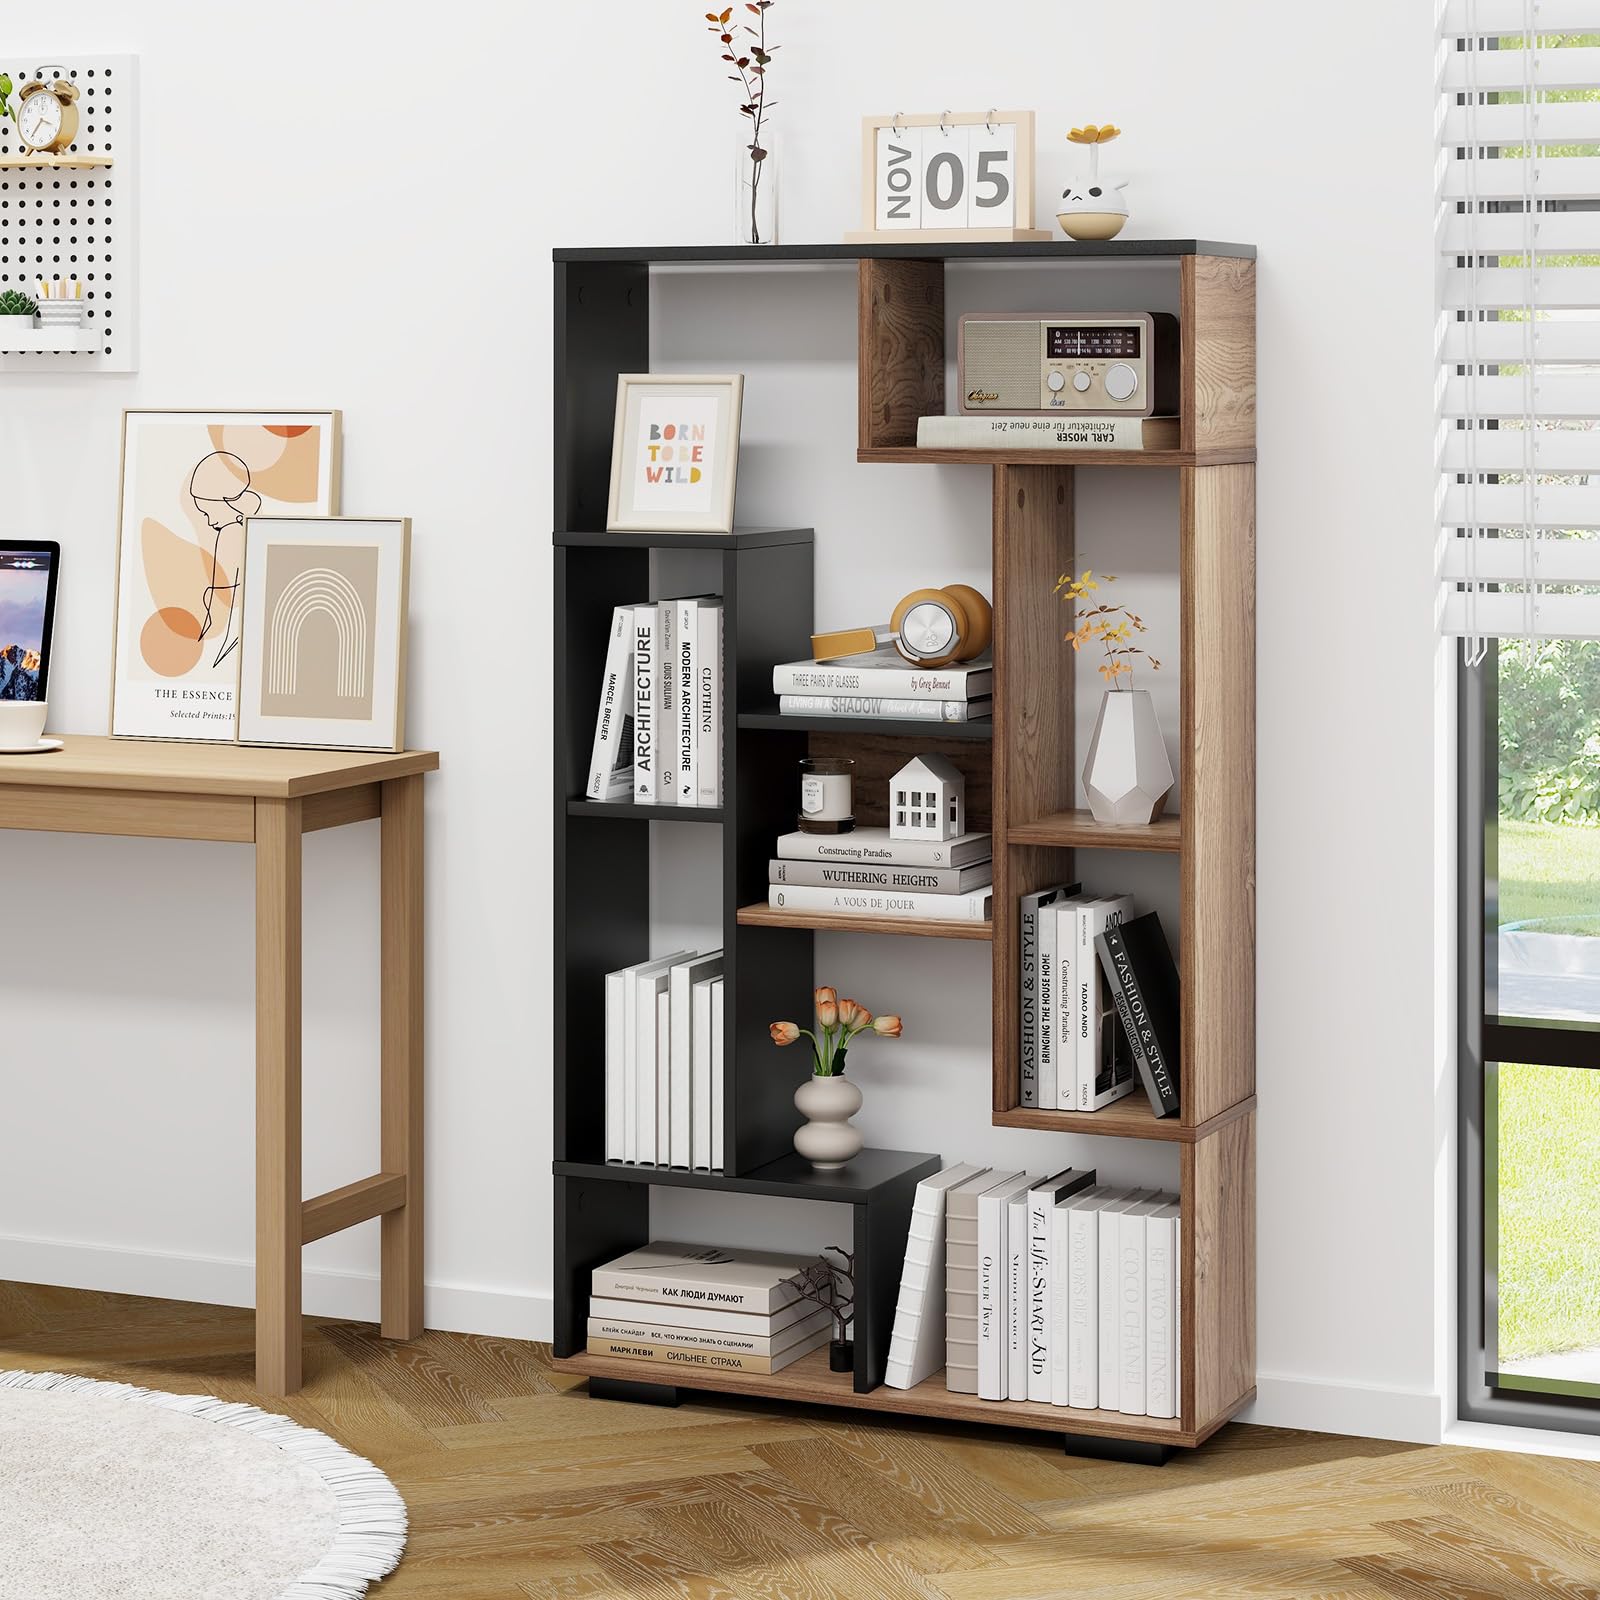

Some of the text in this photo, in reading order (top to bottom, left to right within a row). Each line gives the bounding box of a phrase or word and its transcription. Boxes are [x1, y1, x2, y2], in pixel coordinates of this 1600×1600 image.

[887, 144, 912, 219] NOV
[926, 150, 1010, 210] 05
[650, 424, 705, 440] BORN
[991, 422, 1116, 432] Architektur für eine neue Zeit
[1056, 432, 1114, 442] CARL MOSER
[648, 445, 704, 462] TO BE
[646, 466, 702, 484] WILD
[664, 662, 672, 710] LOUIS SULLIVAN
[792, 674, 859, 688] THREE PAIRS OF GLASSES
[911, 676, 918, 692] by
[918, 676, 932, 692] Greg
[155, 689, 232, 700] THE ESSENCE
[638, 626, 651, 772] ARCHITECTURE
[702, 668, 712, 733] CLOTHING
[170, 710, 200, 719] Selected
[600, 672, 617, 741] MARCEL BREUER
[681, 642, 690, 772] MODERN ARCHITECTURE
[831, 698, 882, 714] SHADOW
[818, 846, 892, 859] Constructing Paradies
[822, 870, 938, 887] WUTHERING HEIGHTS
[834, 896, 914, 911] A VOUS DE JOUER
[1105, 910, 1122, 931] ANDO
[1024, 914, 1034, 1080] FASHION & STYLE
[1060, 960, 1070, 1044] Constructing Paradies
[1042, 953, 1050, 1064] BRINGING THE HOUSE HOME
[1114, 952, 1172, 1098] FASHION & STYLE
[1114, 991, 1144, 1060] DESIGN COLLECTION
[662, 1288, 744, 1304] КАК ЛЮДИ ДУМАЮТ
[699, 1336, 716, 1345] ЗНАТЬ
[610, 1346, 653, 1356] МАРК ЛЕВИ
[666, 1352, 742, 1368] СИЛЬНЕЕ СТРАХА
